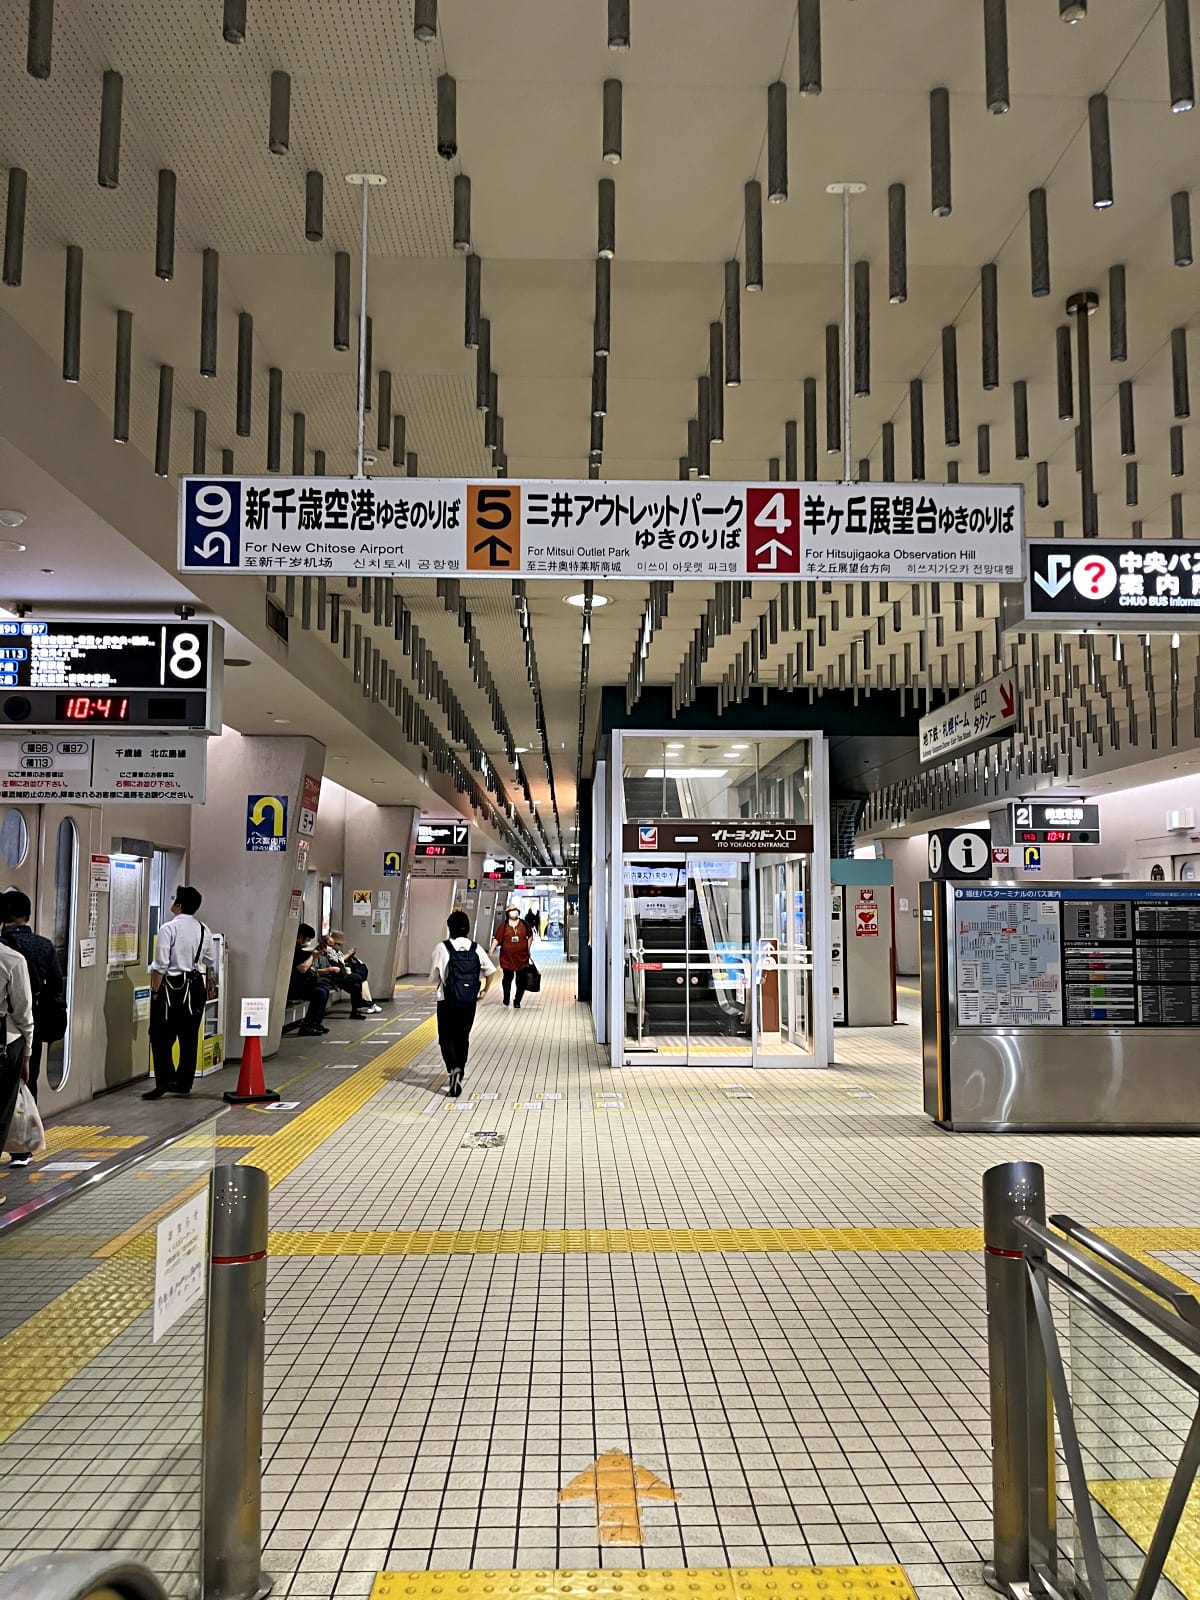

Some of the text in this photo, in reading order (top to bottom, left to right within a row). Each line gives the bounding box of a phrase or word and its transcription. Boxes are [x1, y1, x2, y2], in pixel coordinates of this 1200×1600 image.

[195, 485, 231, 527] 9
[245, 487, 461, 531] 新千歳空港ゆきのりば
[476, 490, 512, 530] 5
[527, 493, 744, 528] 三井アウトレットパーク
[754, 492, 792, 534] 4
[635, 528, 742, 550] ゆきのりば
[245, 543, 404, 556] For New Chitose Airport
[527, 547, 630, 557] For Mitsui Outlet Park
[805, 549, 976, 561] For Hitsujigaoka Observation Hill
[244, 557, 333, 568] 至新千岁机场
[353, 558, 460, 570] 신치토세 공항행
[527, 561, 622, 572] 至三井奥特莱斯商城
[636, 562, 668, 572] 미쓰이
[806, 563, 891, 574] 羊之丘展望台方向
[907, 563, 969, 574] 히쓰지가오카
[1119, 596, 1147, 606] CHUO
[1149, 596, 1168, 606] BUS
[169, 632, 202, 679] 8
[973, 689, 987, 711] 出口
[66, 698, 127, 719] 10:41
[974, 712, 997, 735] タクシー
[1016, 808, 1029, 824] 2
[456, 827, 467, 842] 7
[712, 829, 797, 841] イトーヨーカドー入口
[1047, 832, 1071, 841] 10:41
[507, 861, 514, 871] 6
